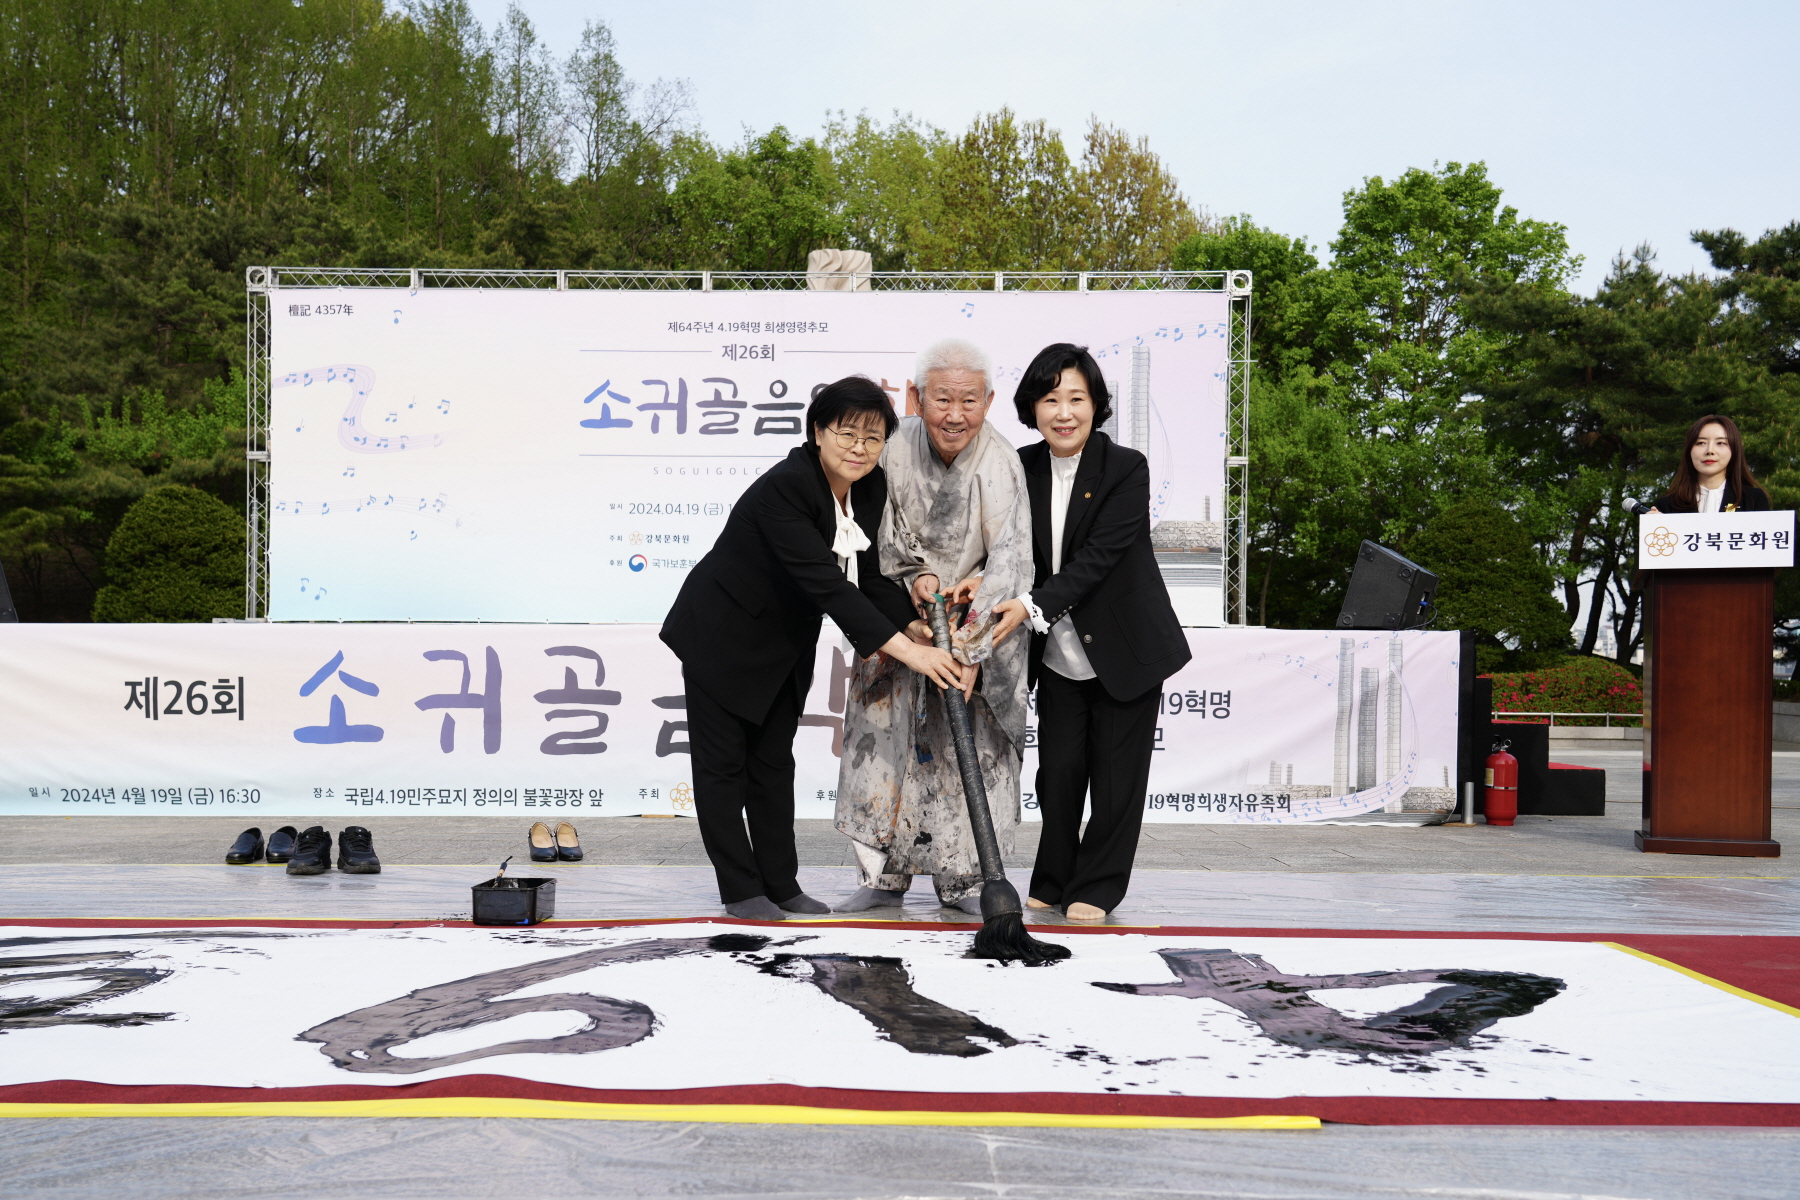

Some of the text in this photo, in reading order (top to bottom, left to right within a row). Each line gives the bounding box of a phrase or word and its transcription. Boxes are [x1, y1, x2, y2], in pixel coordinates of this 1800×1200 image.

[315, 303, 354, 316] 4357年
[667, 321, 829, 333] 제64주년 4.19혁명 희생영령추모
[721, 343, 775, 361] 제26회
[609, 502, 623, 510] 일시
[628, 502, 700, 516] 2024.04.19
[703, 502, 724, 516] (금)
[645, 534, 690, 544] 강북문화원
[1682, 530, 1790, 552] 강북문화원
[123, 675, 246, 721] 제26회
[28, 786, 261, 806] 일시 2024년 4월 19일 (금) 16:30
[313, 787, 604, 807] 장소 국립4.19민주묘지 정의의 불꽃광장 앞
[639, 788, 659, 800] 주최
[816, 789, 837, 801] 후원
